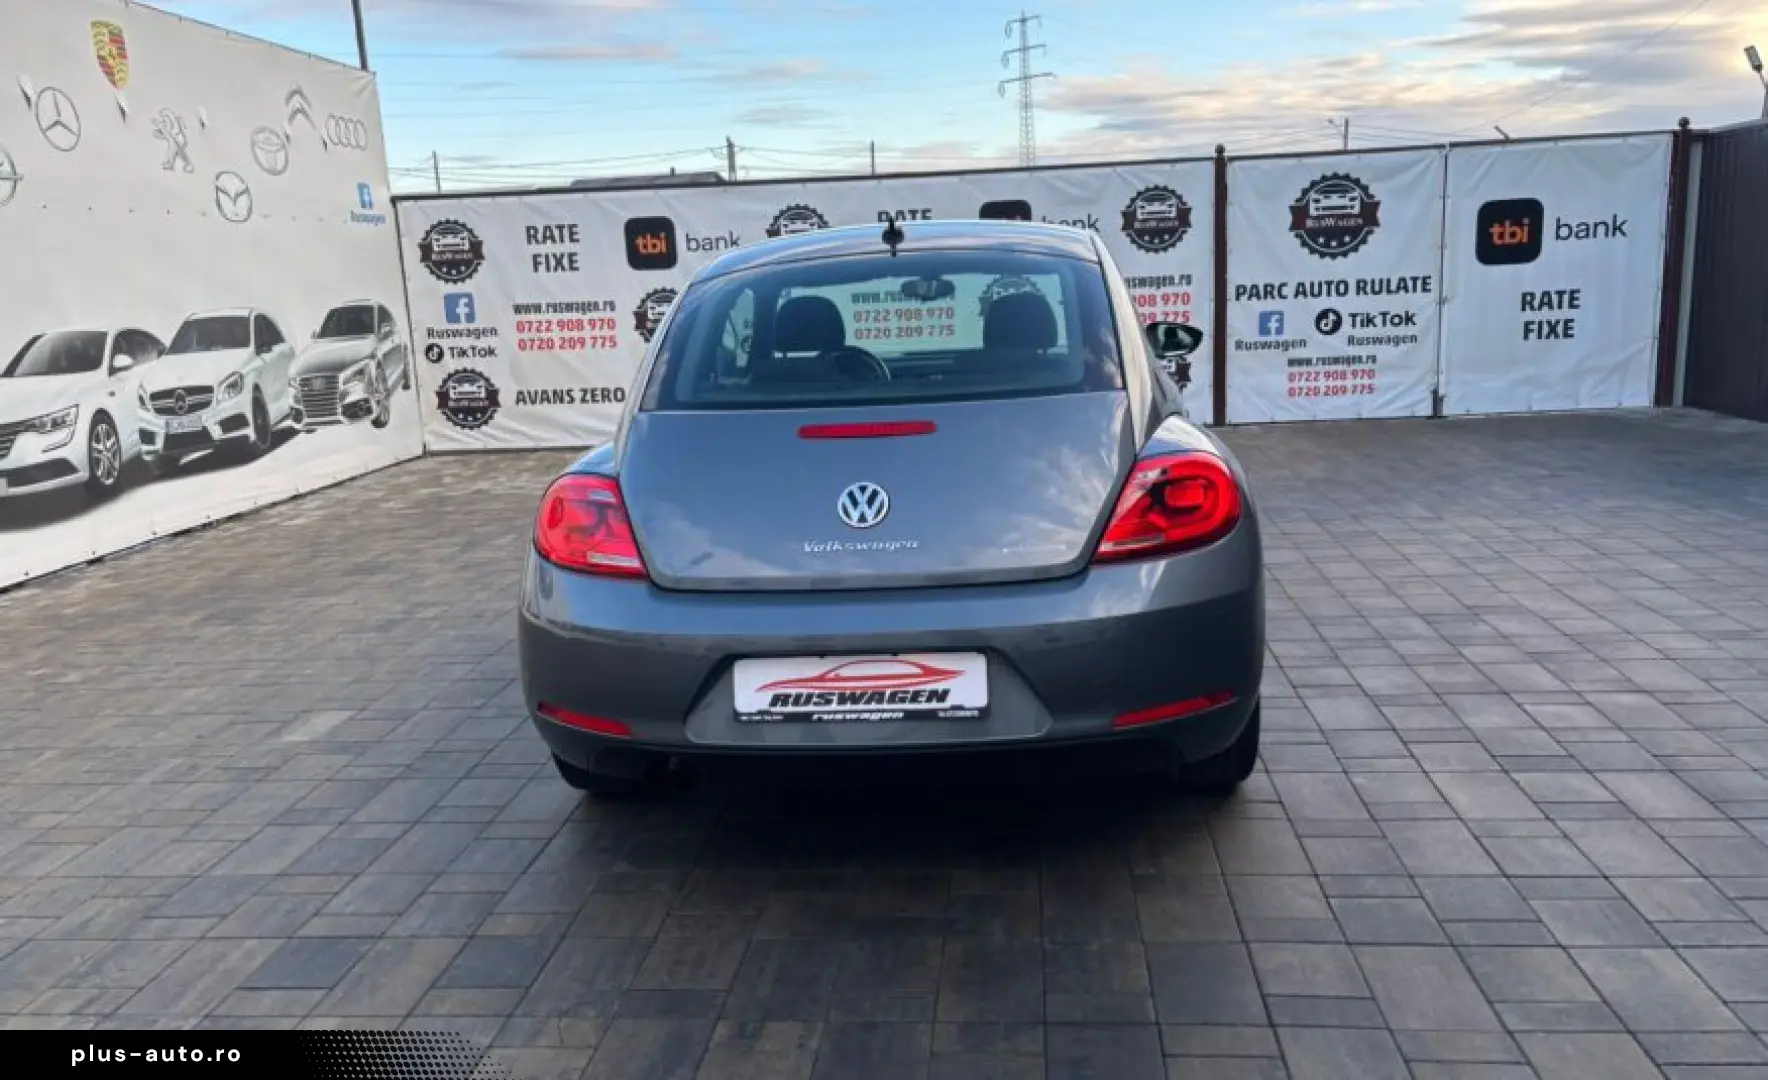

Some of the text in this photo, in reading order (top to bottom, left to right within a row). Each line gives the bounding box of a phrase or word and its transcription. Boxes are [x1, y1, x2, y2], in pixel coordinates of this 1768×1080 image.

[525, 223, 580, 245] RATE
[1489, 213, 1628, 245] tbi bank
[635, 229, 741, 254] tbi bank
[532, 251, 580, 273] FIXE
[1235, 275, 1431, 301] PARC AUTO RULATE
[1162, 292, 1191, 306] 970
[1520, 288, 1581, 312] RATE
[517, 317, 616, 333] 0722 908 970
[1162, 310, 1191, 324] 775
[1348, 310, 1417, 328] TikTok
[427, 326, 498, 340] Ruswagen
[1523, 318, 1575, 341] FIXE
[518, 334, 617, 352] 0720 209 775
[1235, 338, 1307, 352] Ruswagen
[1347, 334, 1418, 348] Ruswagen
[450, 344, 498, 359] TikTok
[1288, 368, 1376, 383] 0722 908 970
[515, 387, 627, 405] AVANS ZERO
[1288, 383, 1376, 398] 0720 209 775
[768, 688, 951, 708] RUSWAGEN
